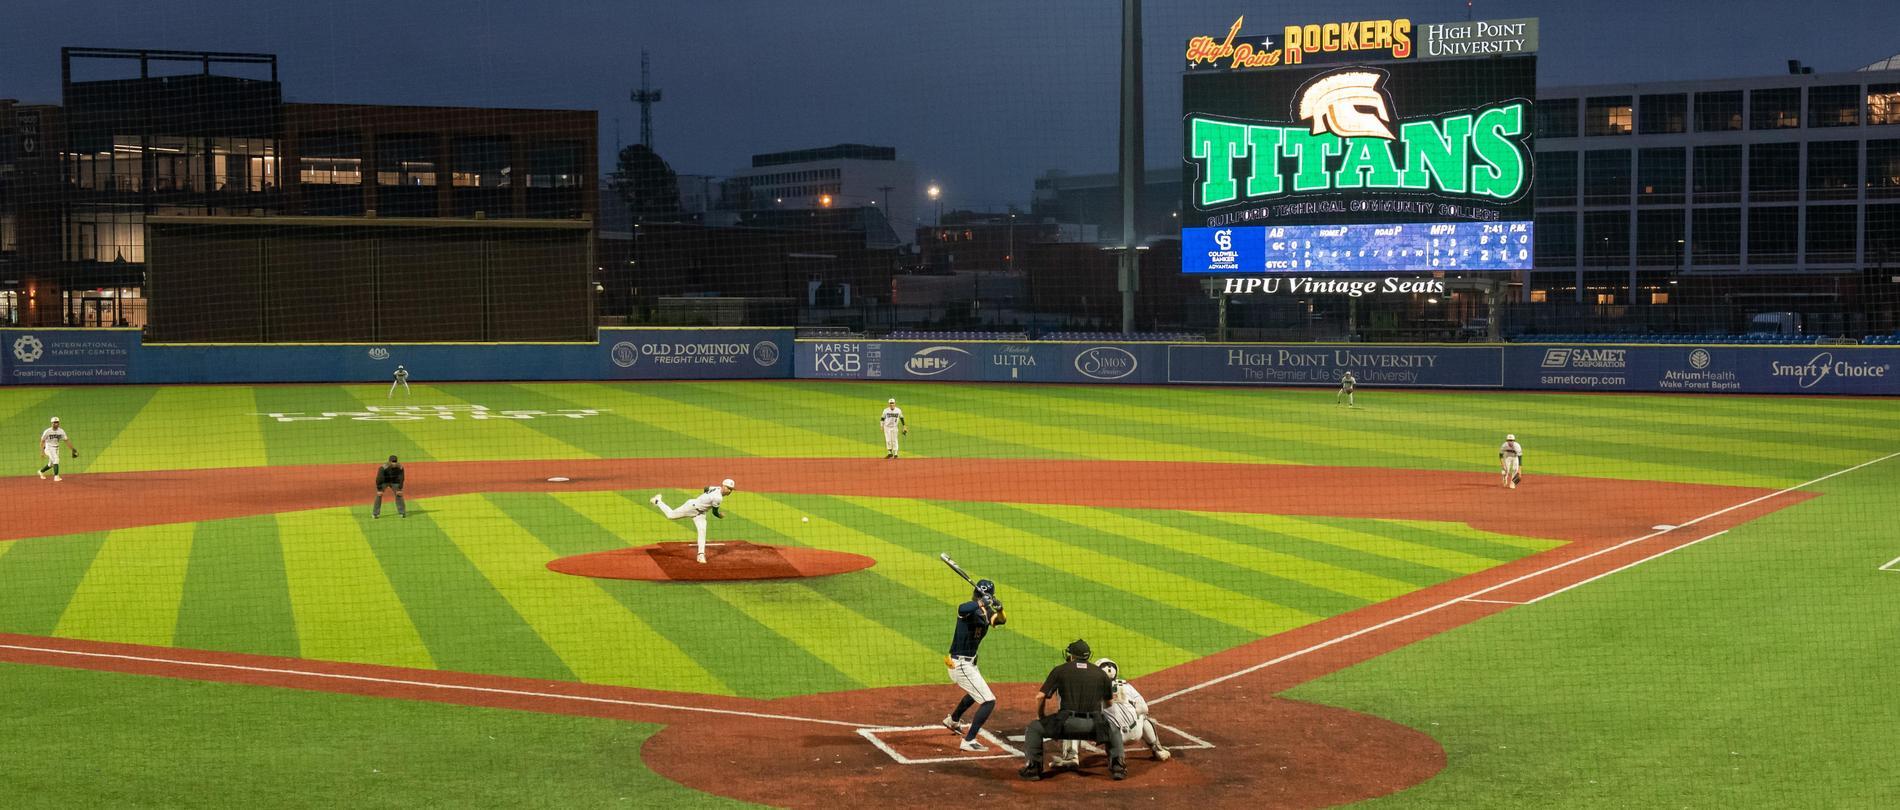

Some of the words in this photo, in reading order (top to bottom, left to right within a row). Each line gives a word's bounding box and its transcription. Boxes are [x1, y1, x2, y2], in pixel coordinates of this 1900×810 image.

[1428, 24, 1471, 40] HIGH
[1477, 21, 1526, 38] POINT
[1186, 20, 1242, 63] High
[1231, 44, 1282, 69] Point
[1284, 18, 1411, 65] ROCKERS
[1428, 39, 1525, 56] UNIVERSITY
[1191, 103, 1524, 206] TITANS
[1268, 227, 1285, 239] AB
[1430, 224, 1457, 236] MPH
[1483, 224, 1504, 233] 7:41
[1480, 235, 1489, 246] B
[1500, 235, 1508, 245] S
[1480, 249, 1489, 261] 2
[1500, 249, 1507, 261] 1
[1519, 248, 1528, 260] 0
[1265, 260, 1288, 268] GTCC
[1223, 277, 1281, 294] HPU
[1287, 277, 1376, 298] Vintage
[1382, 276, 1445, 294] Seats
[641, 343, 671, 355] OLD
[675, 343, 750, 355] DOMINION
[815, 343, 860, 352] MARSH
[654, 356, 692, 364] FREIGHT
[694, 356, 717, 365] LINE,
[719, 356, 737, 364] INC.
[993, 354, 1036, 366] ULTRA
[1228, 349, 1272, 366] HIGH
[1278, 349, 1329, 367] POINT
[1335, 350, 1437, 367] UNIVERSITY
[1572, 350, 1626, 361] SAMET
[815, 353, 861, 372] K&B
[910, 357, 941, 369] NFI
[1573, 360, 1626, 368] CORPORATION
[1771, 361, 1817, 376] Smart
[13, 368, 46, 378] Creating
[48, 368, 94, 378] Exceptional
[95, 367, 126, 377] Markets
[1243, 367, 1264, 379] The
[1266, 367, 1307, 380] Premier
[1310, 368, 1330, 381] Life
[1363, 369, 1418, 384] University
[1665, 369, 1700, 380] Atrium
[1702, 370, 1736, 381] Health
[1541, 374, 1626, 387] sametcorp.com
[1659, 380, 1682, 389] Wake
[1684, 380, 1710, 389] Forest
[1711, 381, 1741, 390] Baptist
